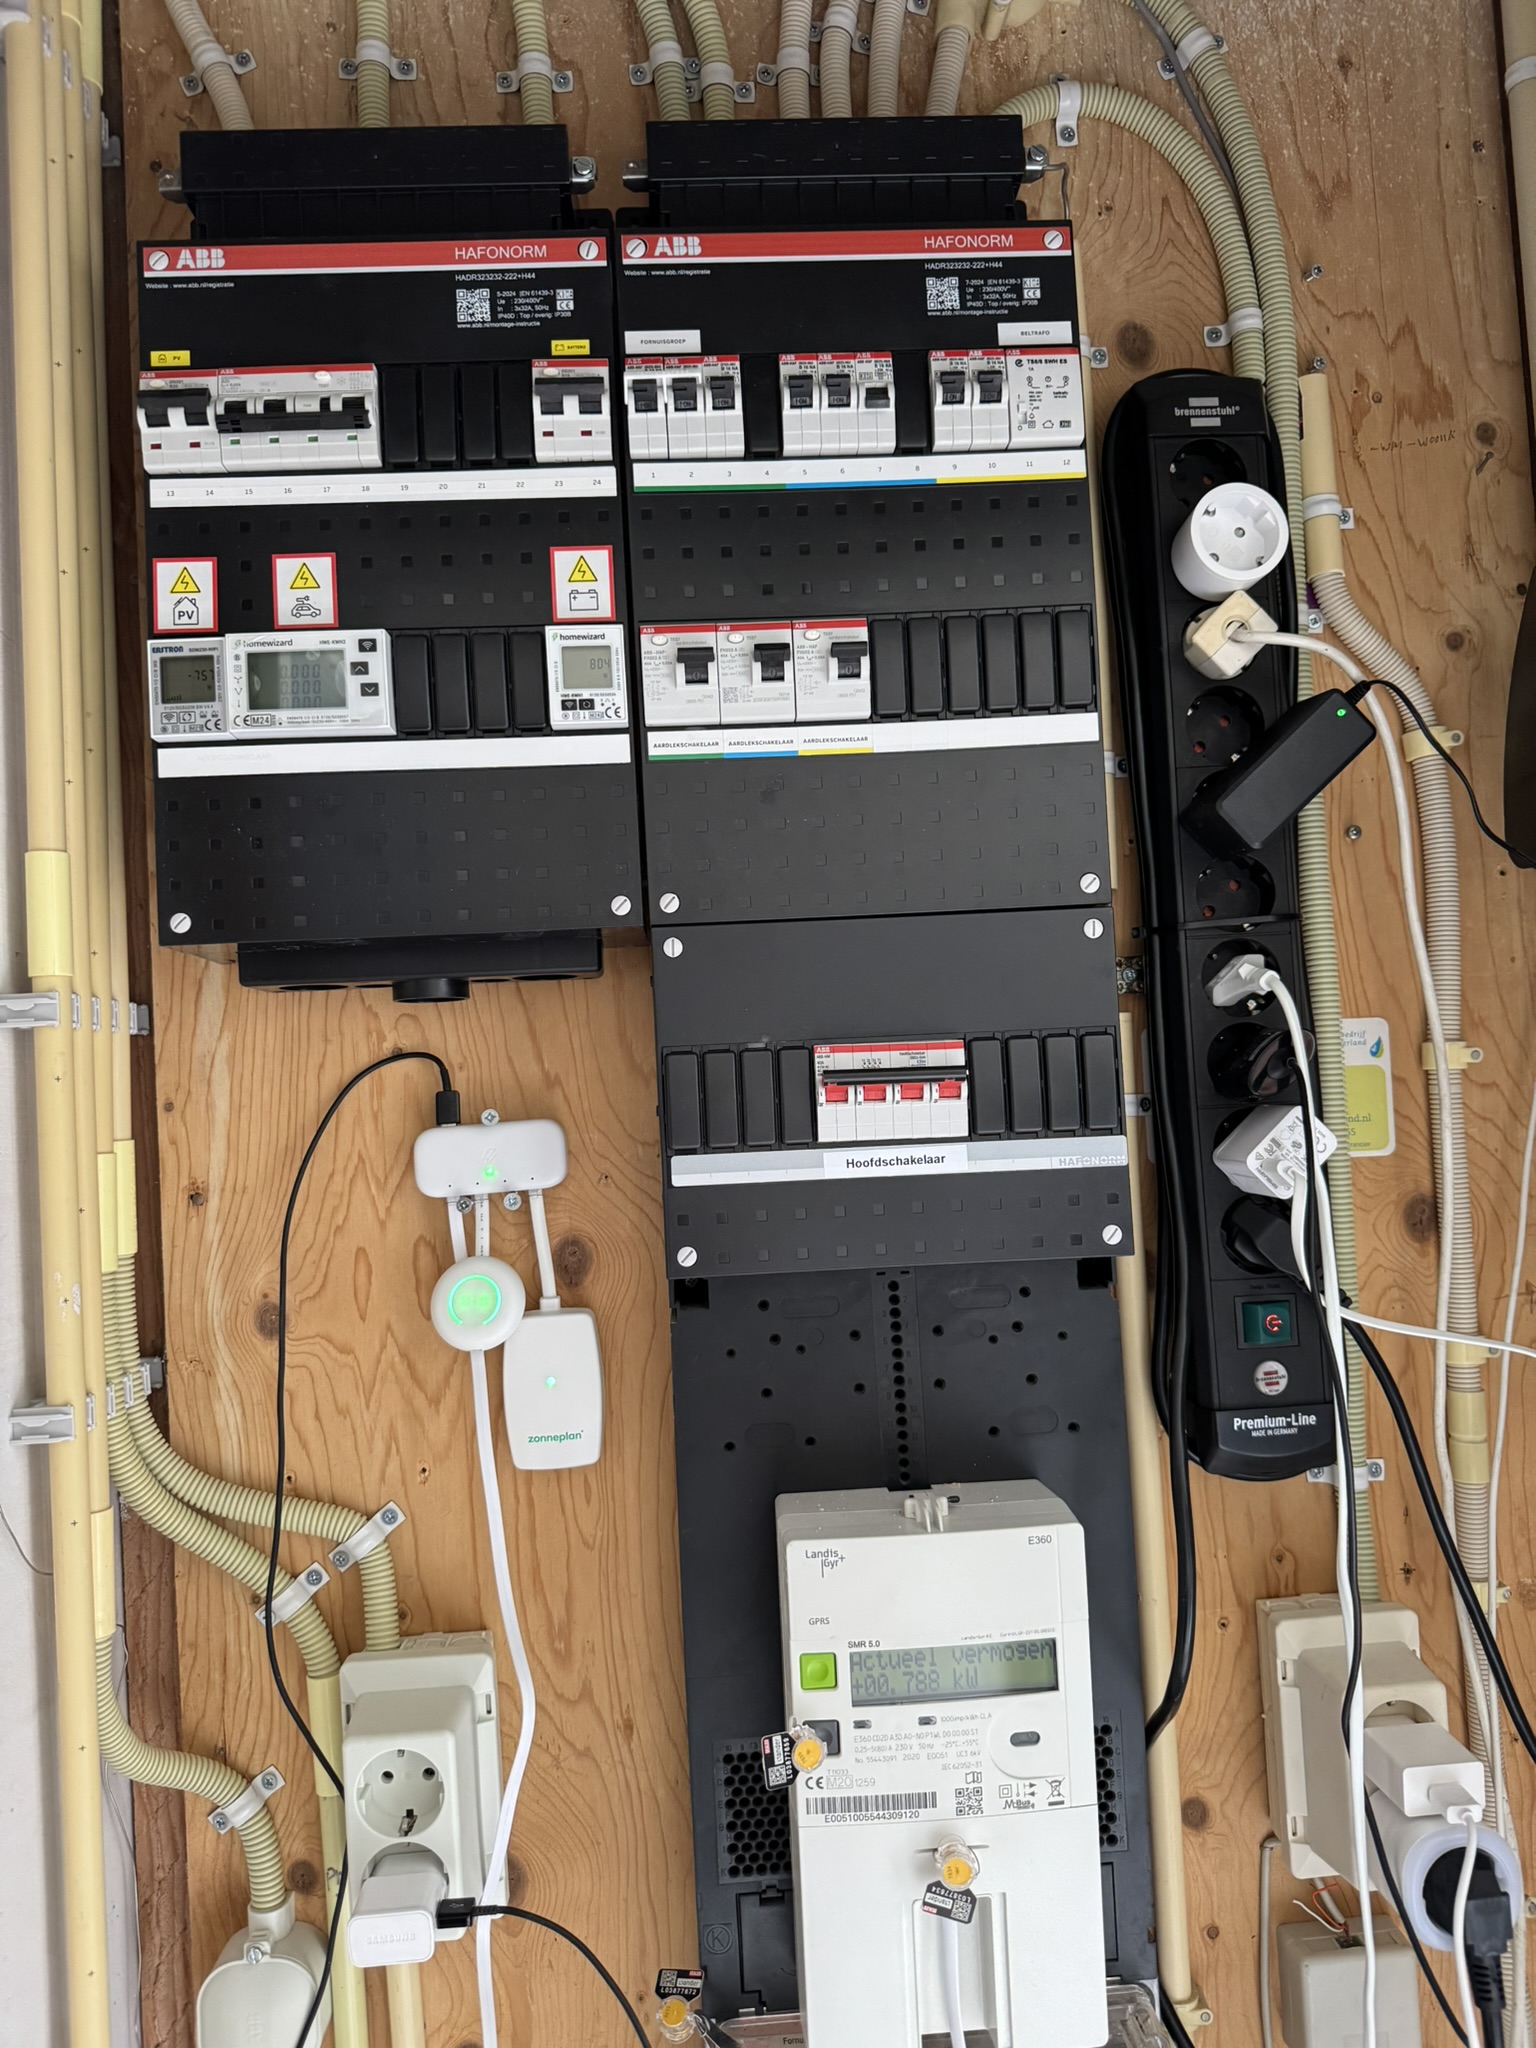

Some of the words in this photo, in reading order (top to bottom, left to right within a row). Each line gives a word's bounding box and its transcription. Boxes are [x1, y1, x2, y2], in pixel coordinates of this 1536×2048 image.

[654, 236, 702, 256] ABB
[924, 234, 1014, 249] HAFONORM
[454, 245, 547, 260] HAFONORM
[176, 248, 226, 269] ABB
[924, 262, 1003, 270] HADR323232-222+H44
[455, 272, 536, 282] HADR323232-222+H44
[650, 268, 711, 276] www.abb.nl/registratie
[178, 611, 194, 620] PV
[590, 658, 610, 670] 804
[252, 715, 270, 724] M24
[846, 1154, 946, 1169] Hoofdschakelaar
[1059, 1155, 1125, 1166] HAFONORM
[1234, 1412, 1316, 1431] Premium-Line
[1252, 1429, 1266, 1437] MADE
[1274, 1427, 1298, 1435] GERMANY
[1028, 1535, 1052, 1545] E360
[808, 1617, 830, 1625] GPRS
[848, 1640, 866, 1648] SMR
[851, 1648, 936, 1672] Actueel
[852, 1669, 940, 1696] +00.788
[953, 1666, 978, 1690] kW
[783, 1737, 794, 1780] L03877659
[866, 1755, 897, 1763] 55443091
[902, 1753, 920, 1761] 2020
[952, 1761, 982, 1770] 62052-31
[828, 1777, 852, 1788] M20
[855, 1778, 876, 1787] 1259
[825, 1811, 919, 1823] E0051005544309120
[367, 1932, 416, 1945] SAMSUNG
[661, 1987, 697, 1995] L03877672
